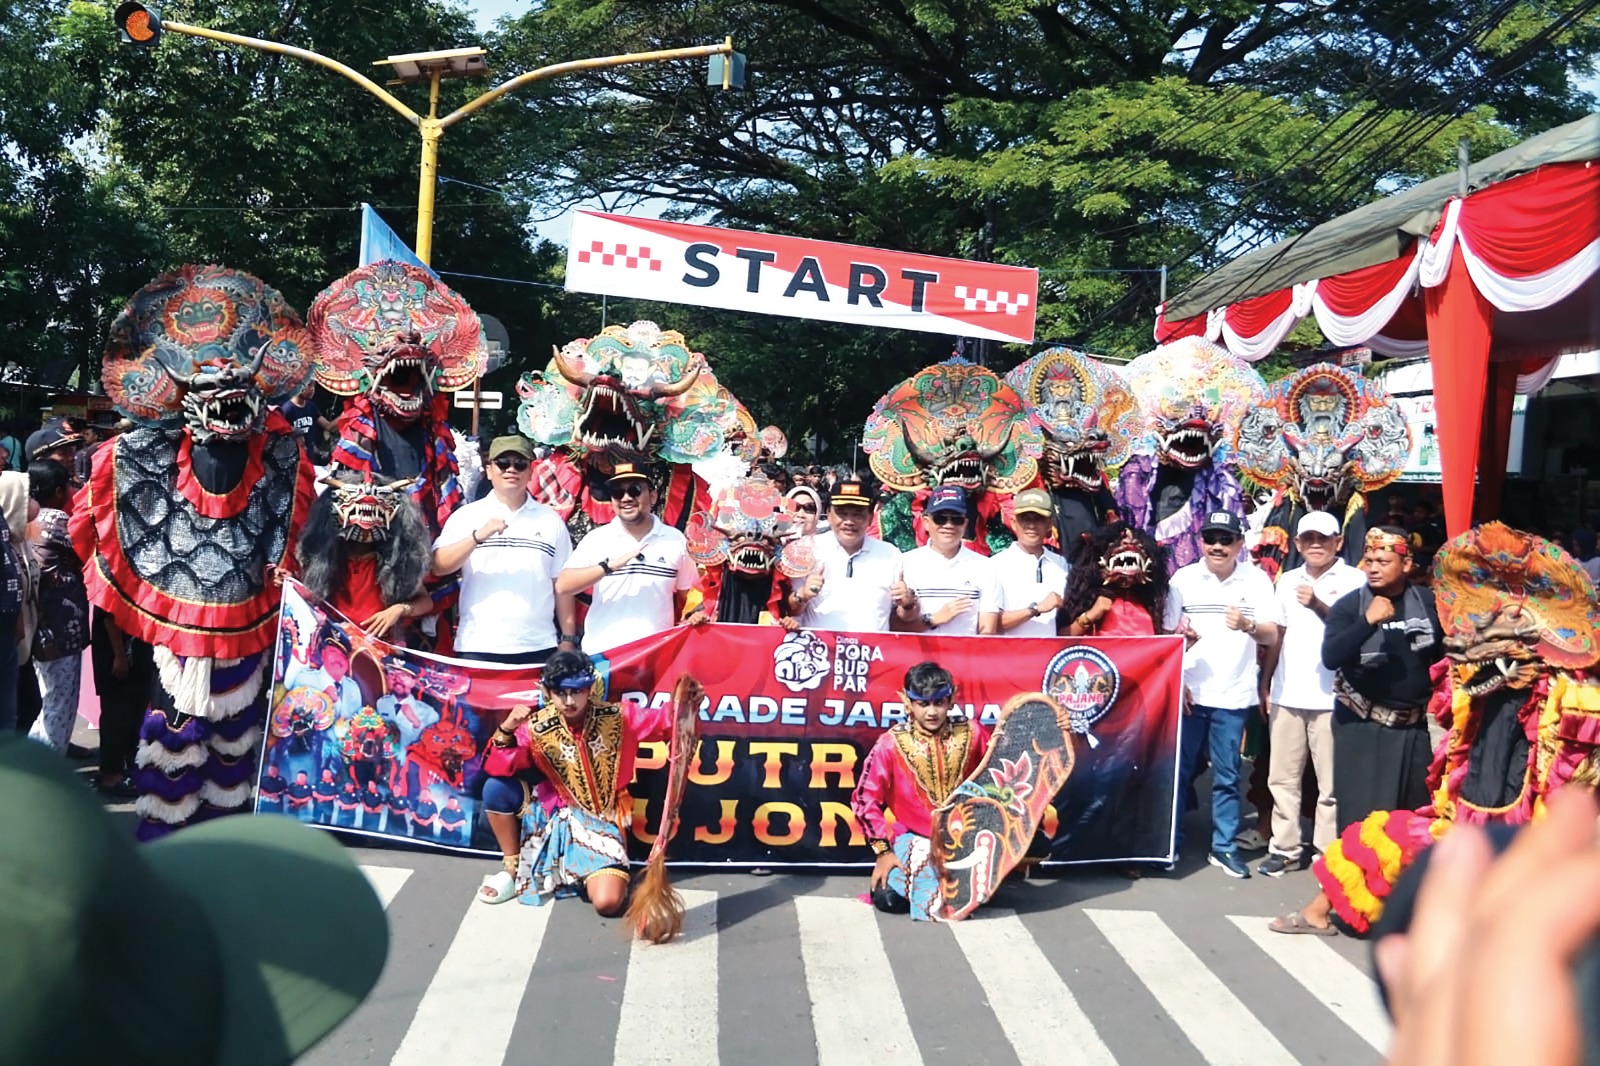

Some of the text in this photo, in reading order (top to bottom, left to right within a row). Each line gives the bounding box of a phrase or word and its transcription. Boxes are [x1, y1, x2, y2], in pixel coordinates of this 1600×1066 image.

[682, 242, 939, 313] START
[836, 635, 859, 645] Dinas
[835, 644, 884, 662] PORA
[834, 659, 869, 676] BUD
[833, 675, 867, 693] PAR
[629, 739, 859, 789] PUTR
